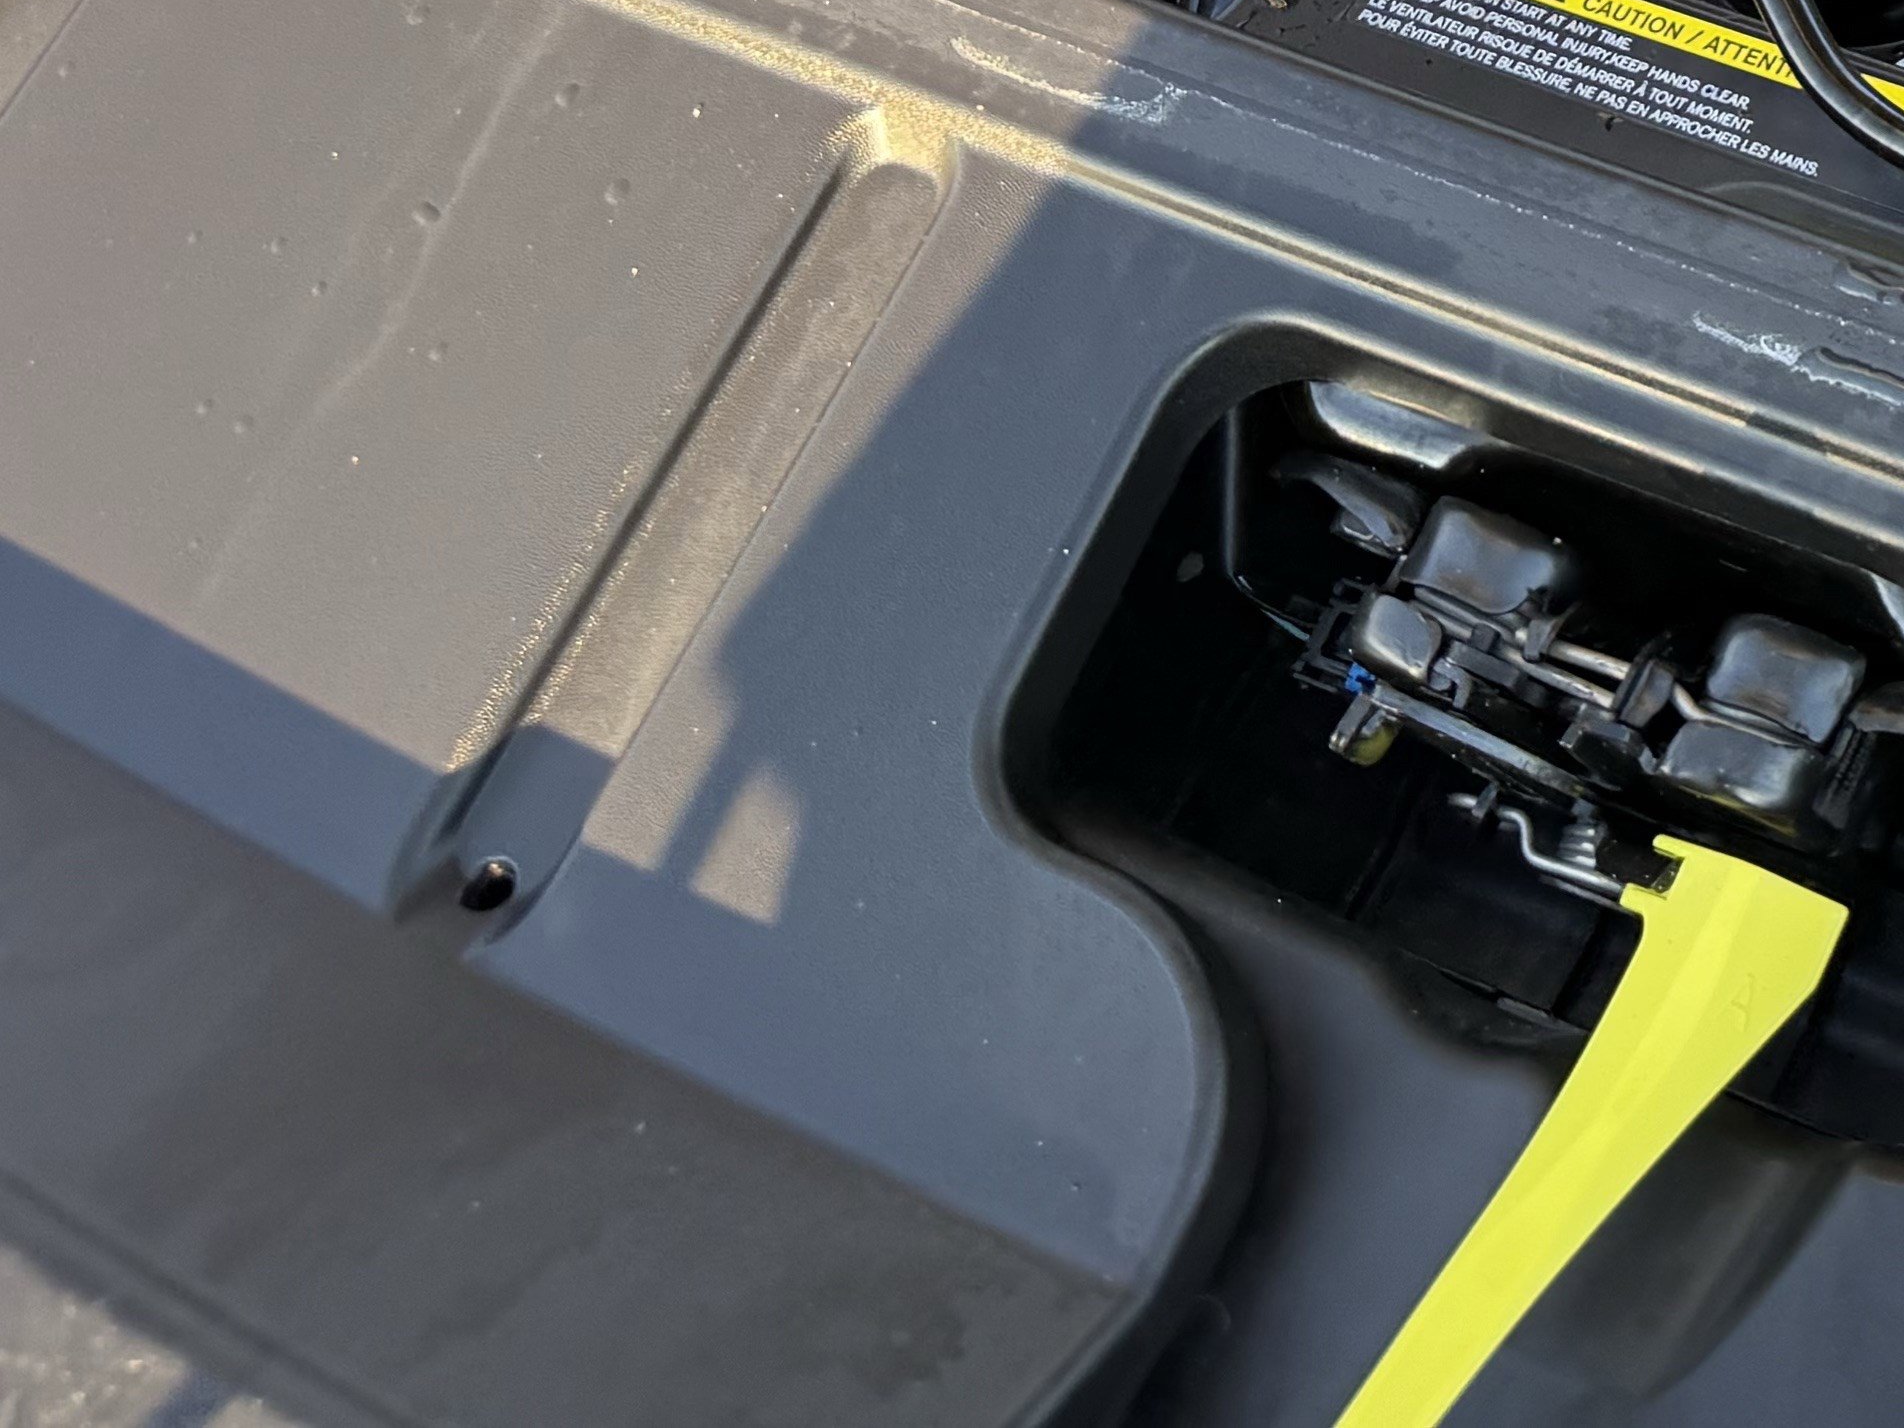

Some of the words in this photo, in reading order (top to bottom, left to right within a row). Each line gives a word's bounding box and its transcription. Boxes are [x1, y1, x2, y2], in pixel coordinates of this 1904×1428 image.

[1385, 0, 1481, 39] VENTILATEUR
[1476, 29, 1536, 58] RISQUE
[1531, 49, 1556, 65] DE
[1552, 53, 1638, 92] DÉMARRER
[1632, 79, 1652, 97] À
[1645, 87, 1688, 110] TOUT
[1684, 101, 1757, 134] MOMENT.
[1481, 11, 1563, 46] PERSONAL
[1645, 66, 1702, 93] HANDS
[1698, 83, 1754, 111] CLEAR.
[1544, 12, 1565, 27] AT
[1563, 19, 1598, 38] ANY
[1597, 30, 1636, 51] TIME.
[1356, 8, 1402, 32] POUR
[1398, 19, 1453, 48] ÉVITER
[1446, 39, 1498, 65] TOUTE
[1492, 55, 1576, 92] BLESSURE,
[1572, 82, 1598, 99] NE
[1594, 89, 1629, 110] PAS
[1625, 100, 1651, 117] EN
[1646, 108, 1743, 148] APPROCHER
[1738, 138, 1772, 159] LES
[1769, 147, 1819, 178] MAINS.
